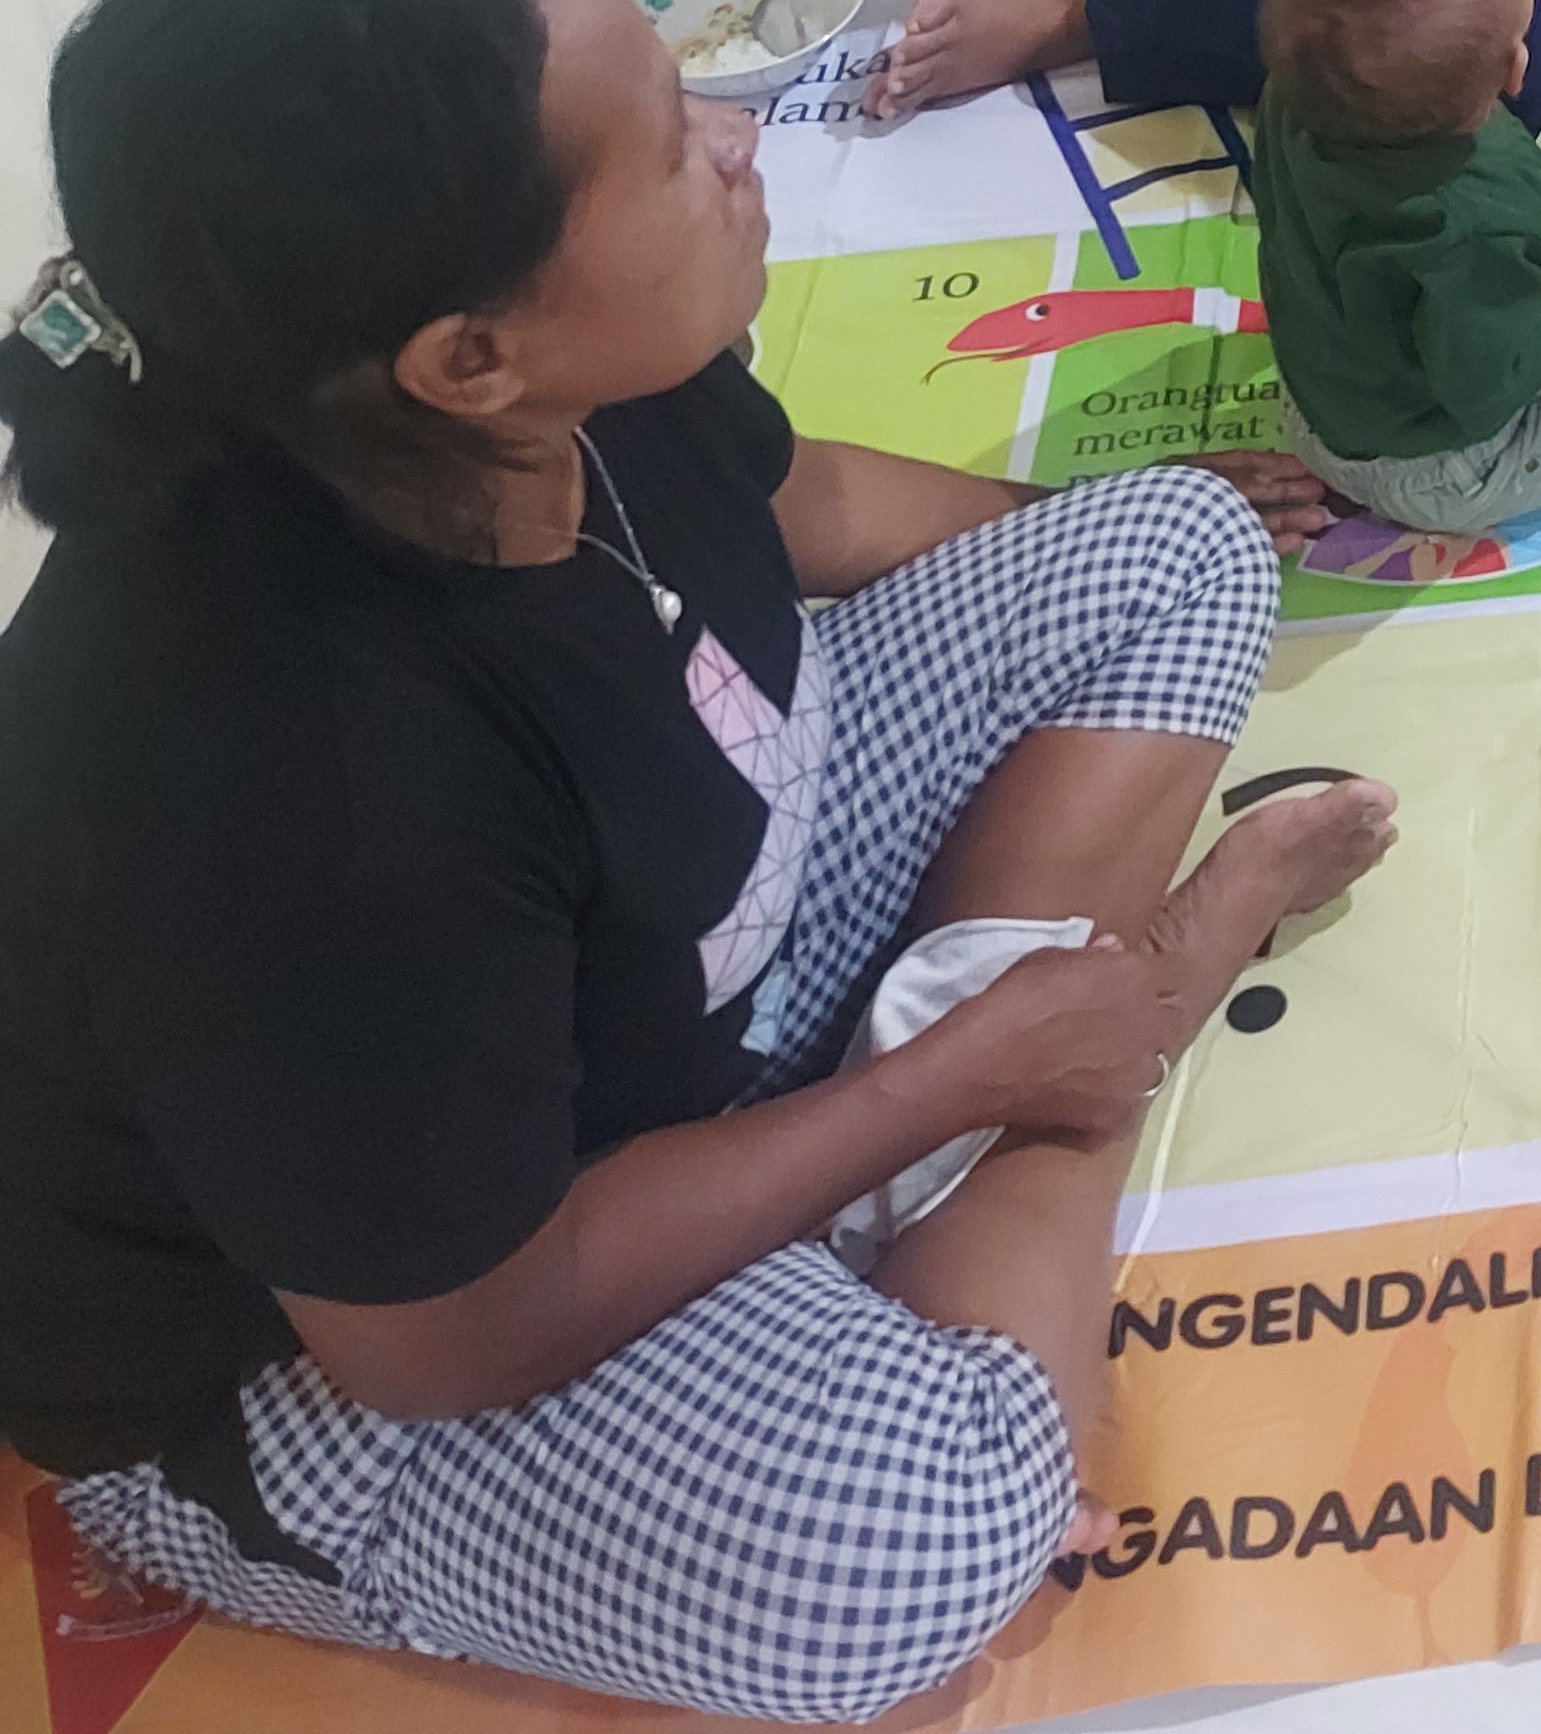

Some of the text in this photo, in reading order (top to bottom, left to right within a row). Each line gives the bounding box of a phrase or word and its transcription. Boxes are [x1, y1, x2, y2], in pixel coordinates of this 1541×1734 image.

[911, 272, 980, 303] 10
[1081, 380, 1281, 417] Orangtua
[1073, 415, 1266, 456] merawat
